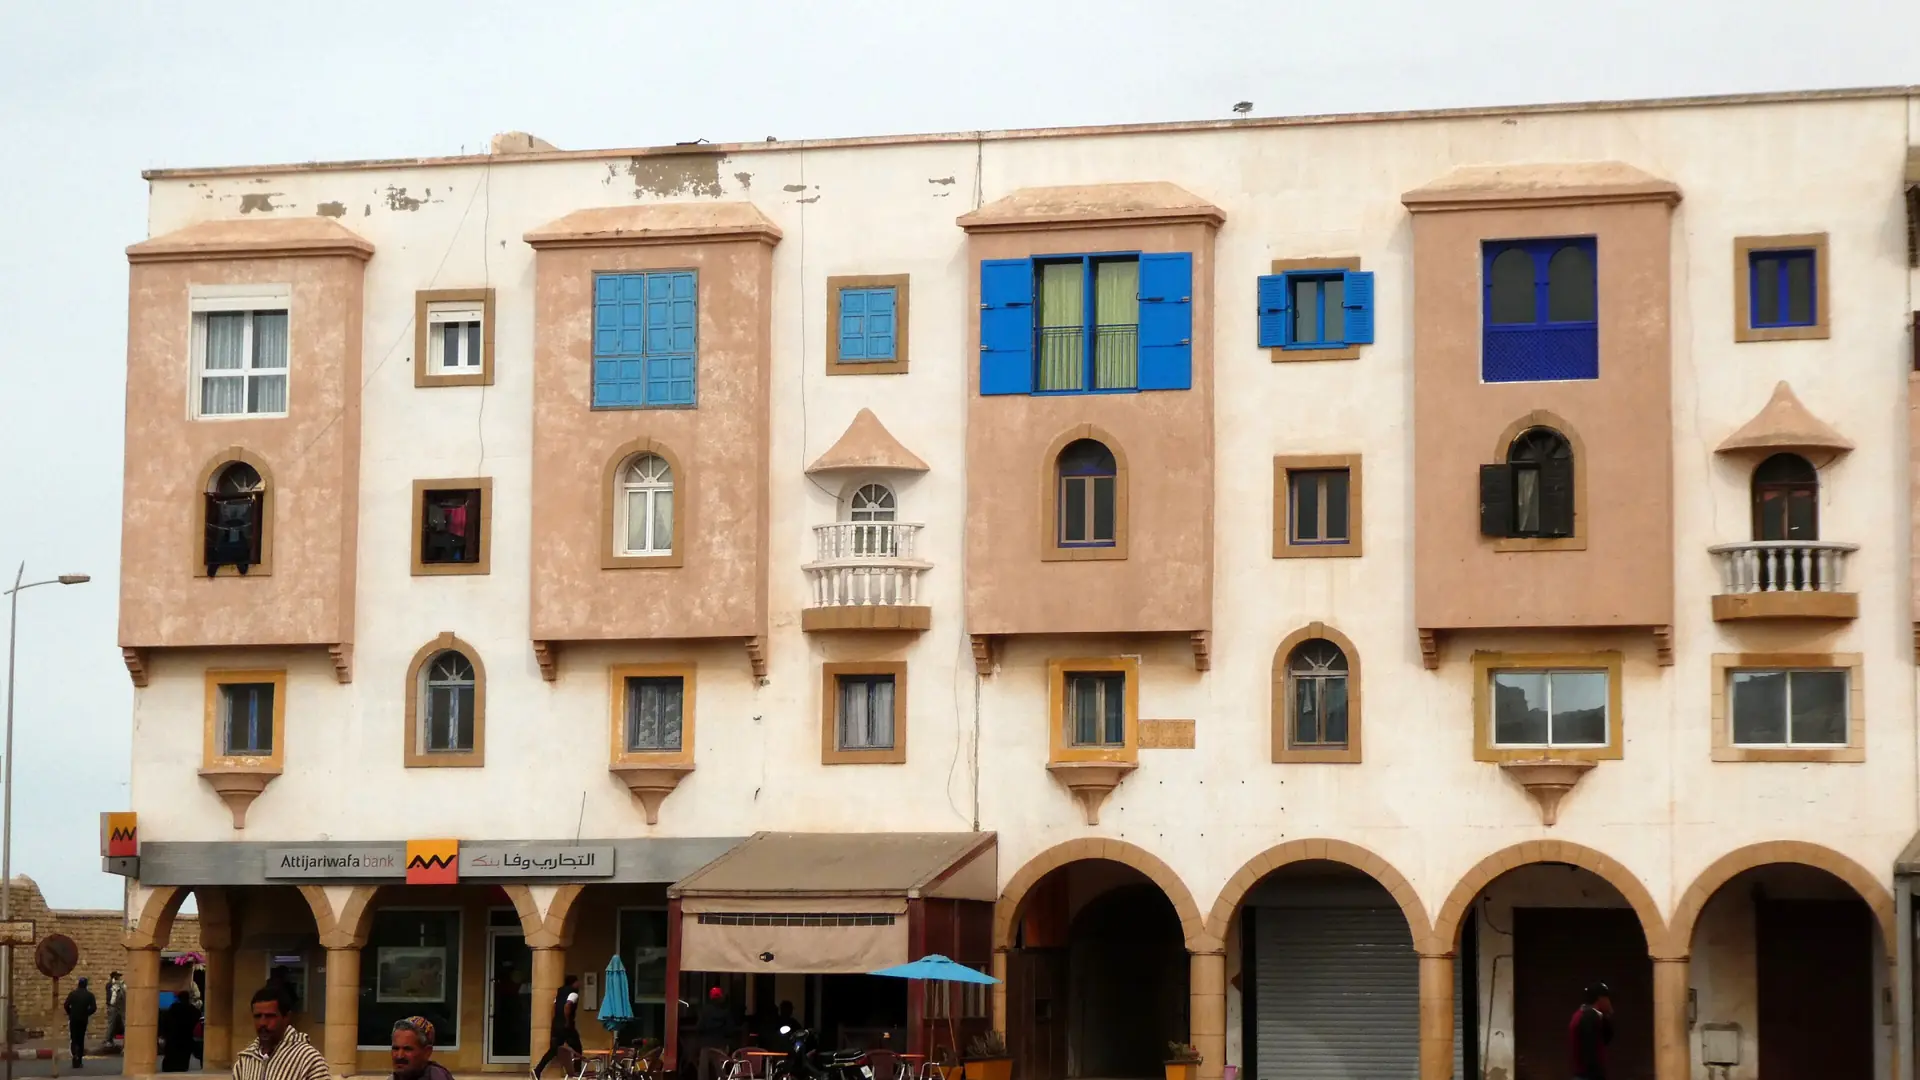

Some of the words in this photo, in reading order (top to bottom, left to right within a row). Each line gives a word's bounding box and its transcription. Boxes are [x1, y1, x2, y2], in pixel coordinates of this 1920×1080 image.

[281, 854, 360, 871] Attijariwafa
[363, 854, 394, 868] bank
[471, 855, 500, 868] بنك
[532, 853, 595, 870] التجاري
